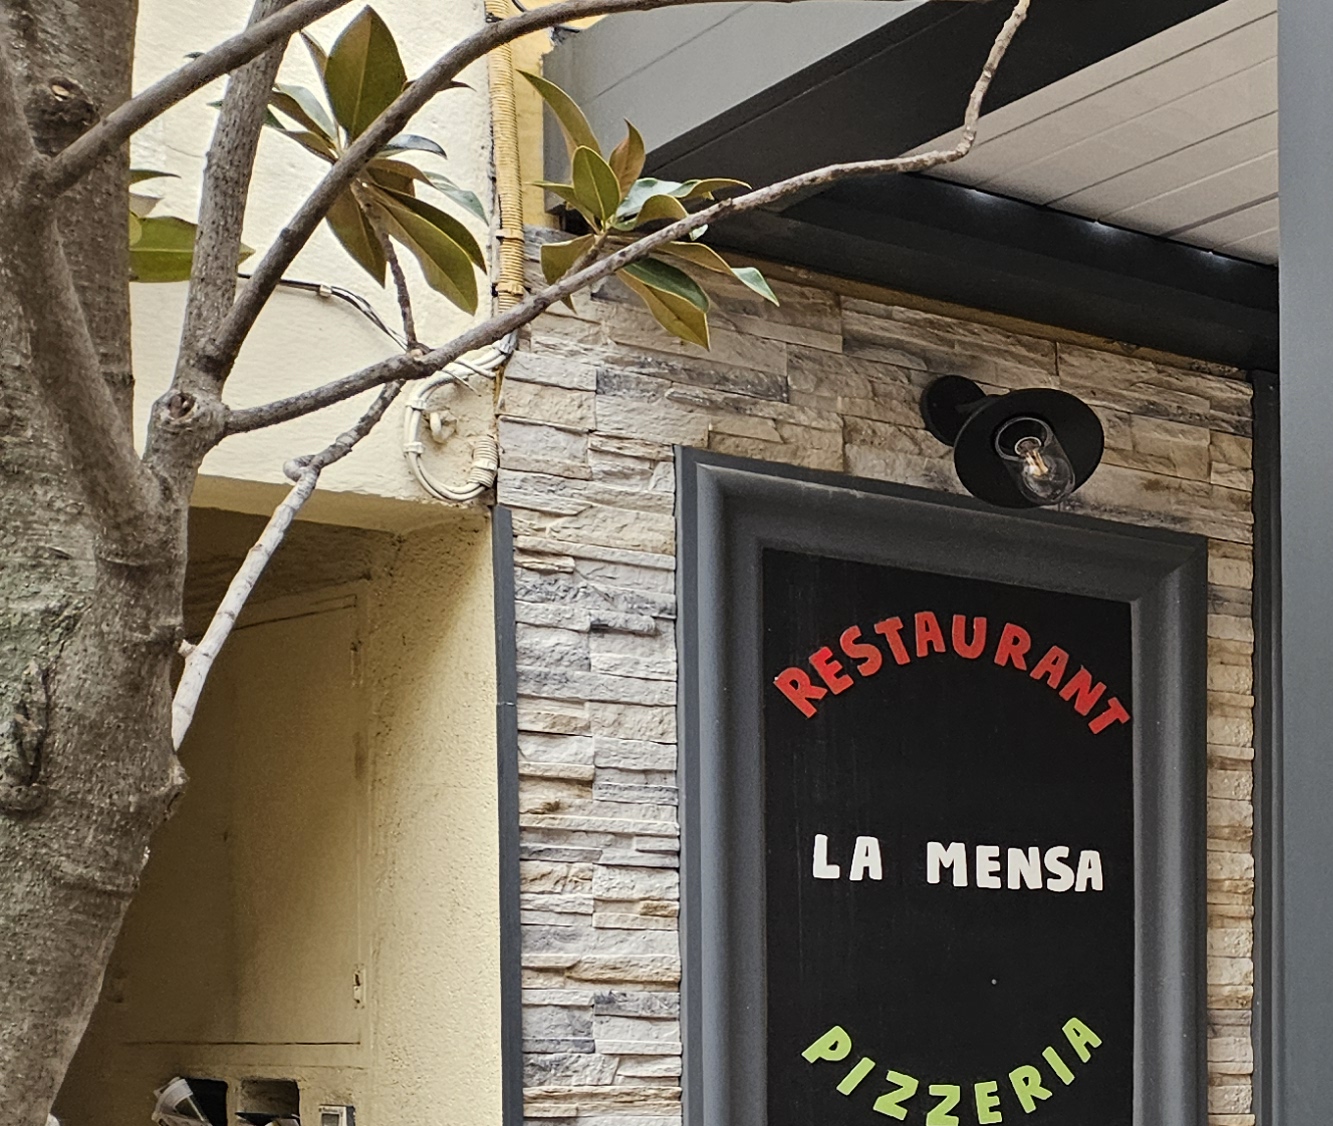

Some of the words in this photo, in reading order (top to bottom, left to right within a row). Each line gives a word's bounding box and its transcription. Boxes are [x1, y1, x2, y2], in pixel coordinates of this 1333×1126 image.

[775, 610, 1131, 736] RESTAURANT
[812, 833, 883, 881] LA
[926, 841, 1104, 893] MENSA
